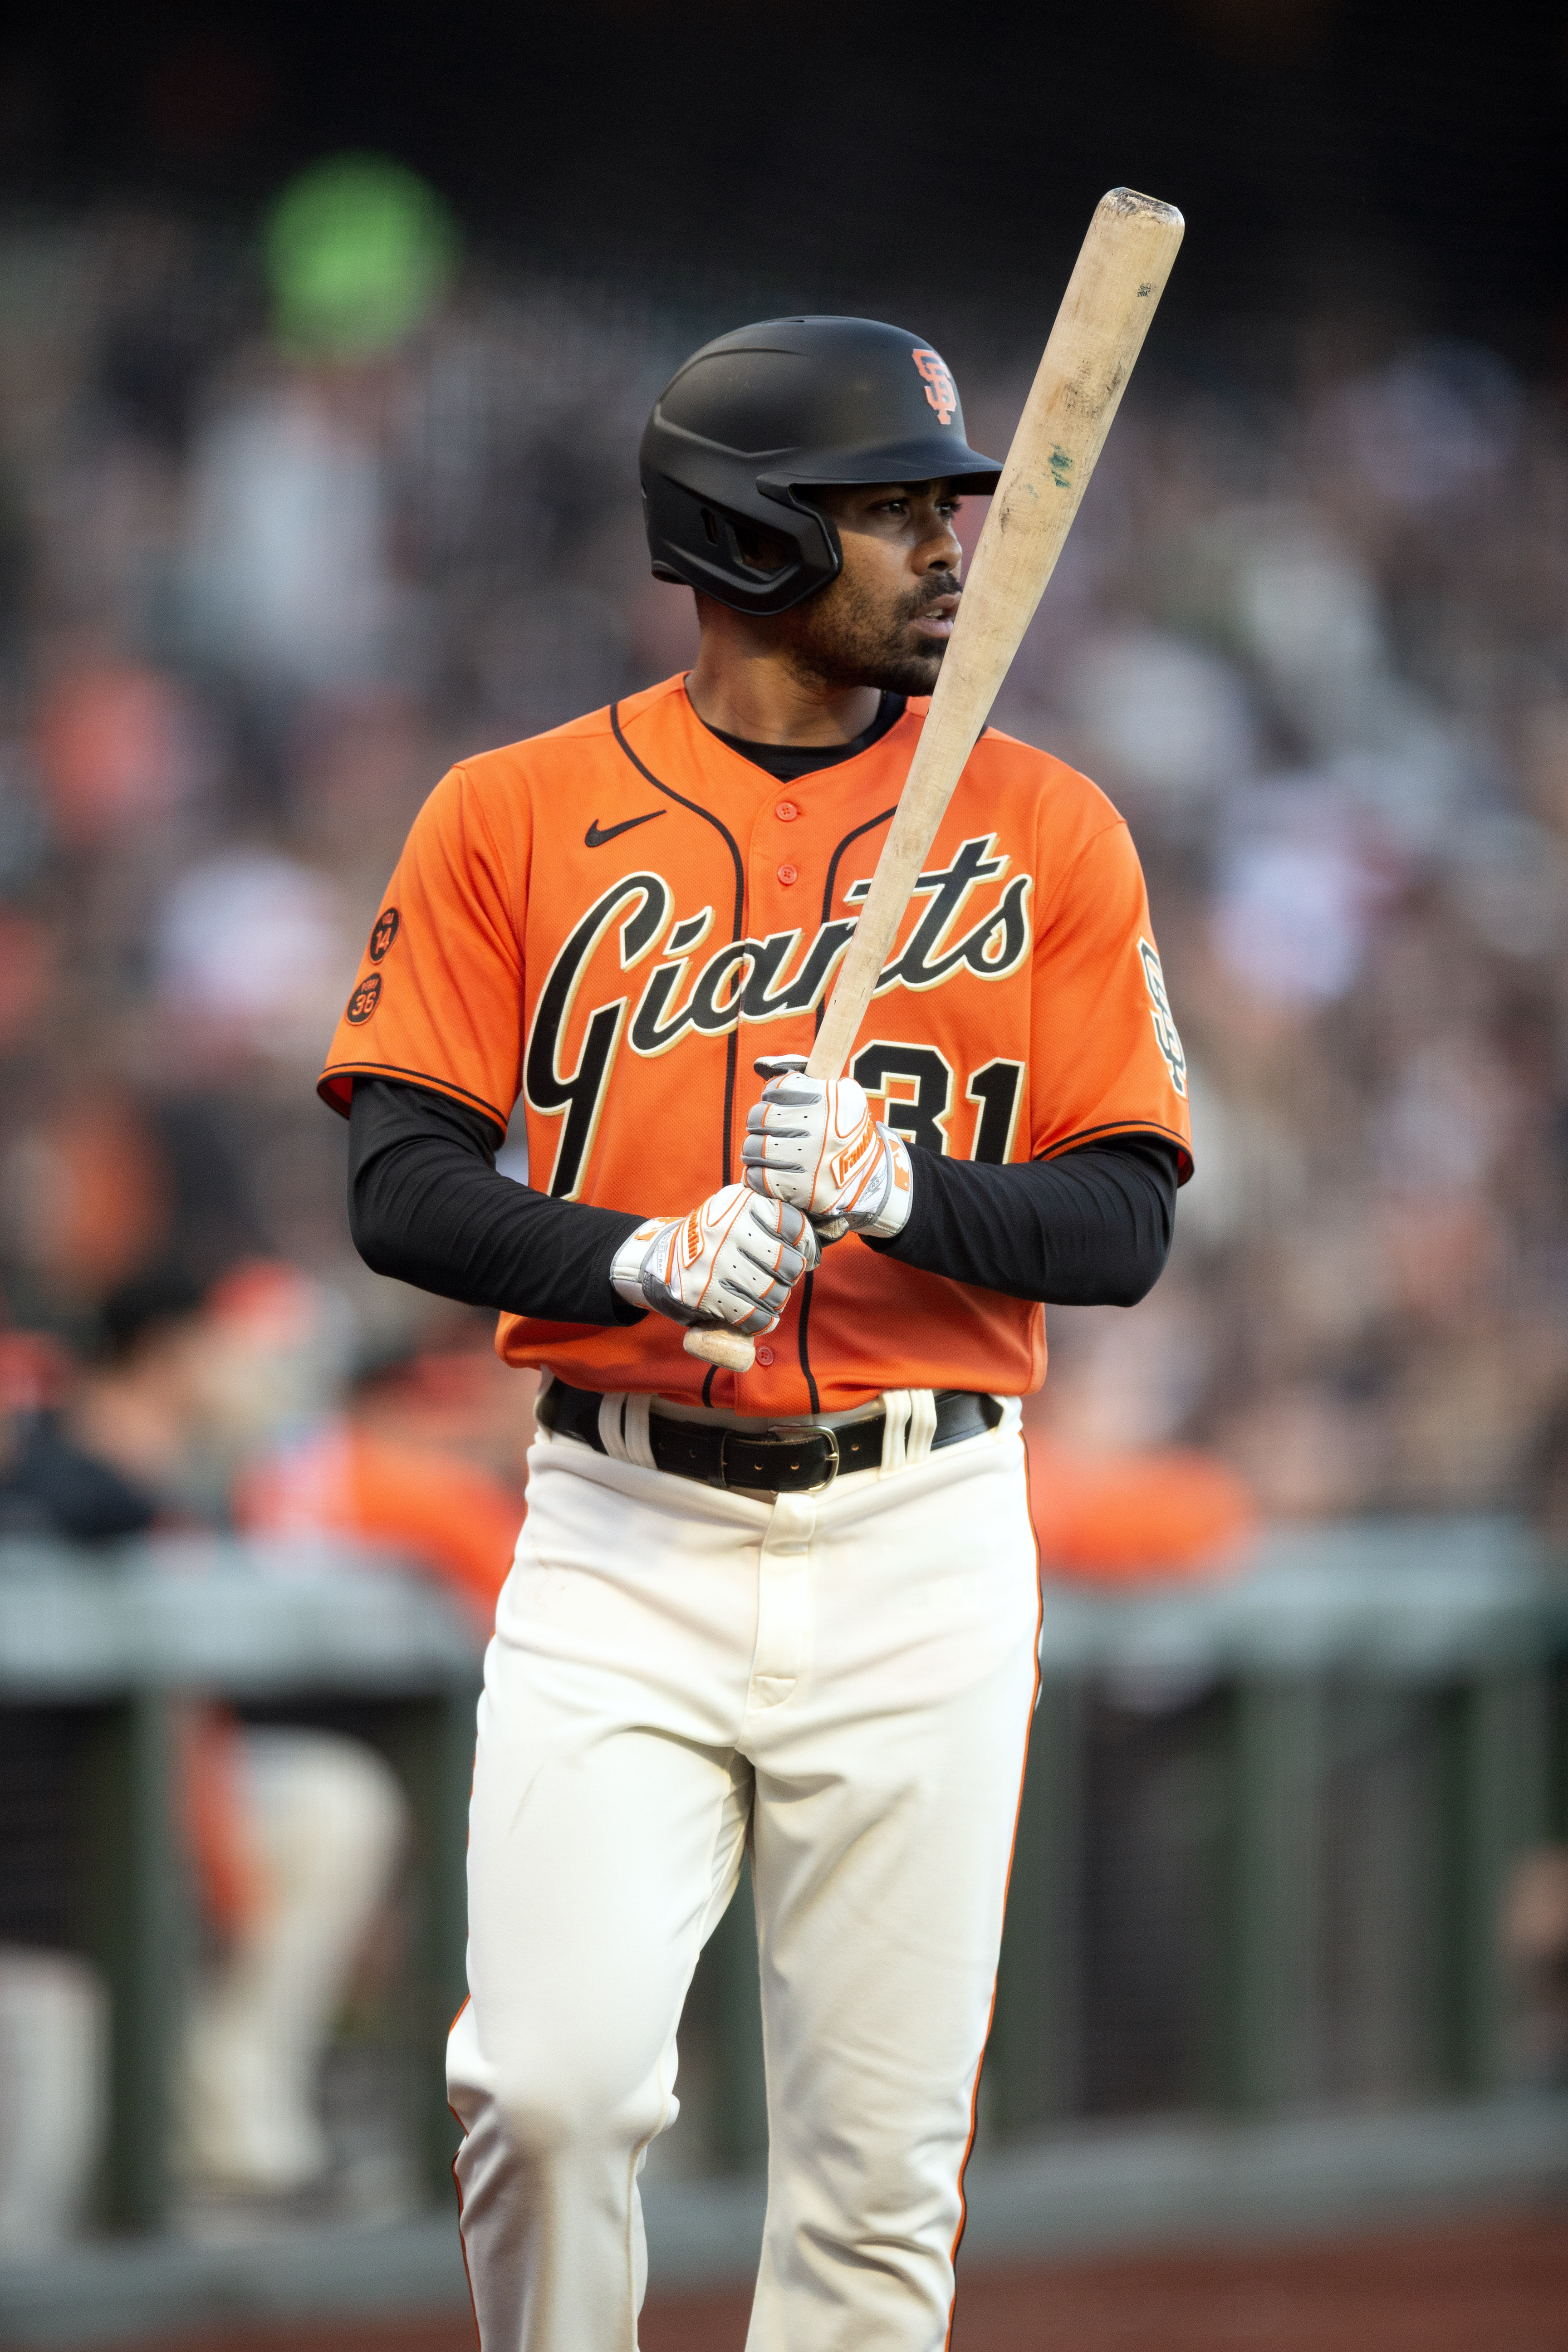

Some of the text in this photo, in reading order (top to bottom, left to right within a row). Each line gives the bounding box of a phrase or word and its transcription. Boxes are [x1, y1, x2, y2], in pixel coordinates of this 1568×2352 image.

[912, 348, 956, 425] SF
[375, 927, 392, 954] 14
[352, 991, 376, 1016] 36
[850, 1040, 1026, 1165] 31
